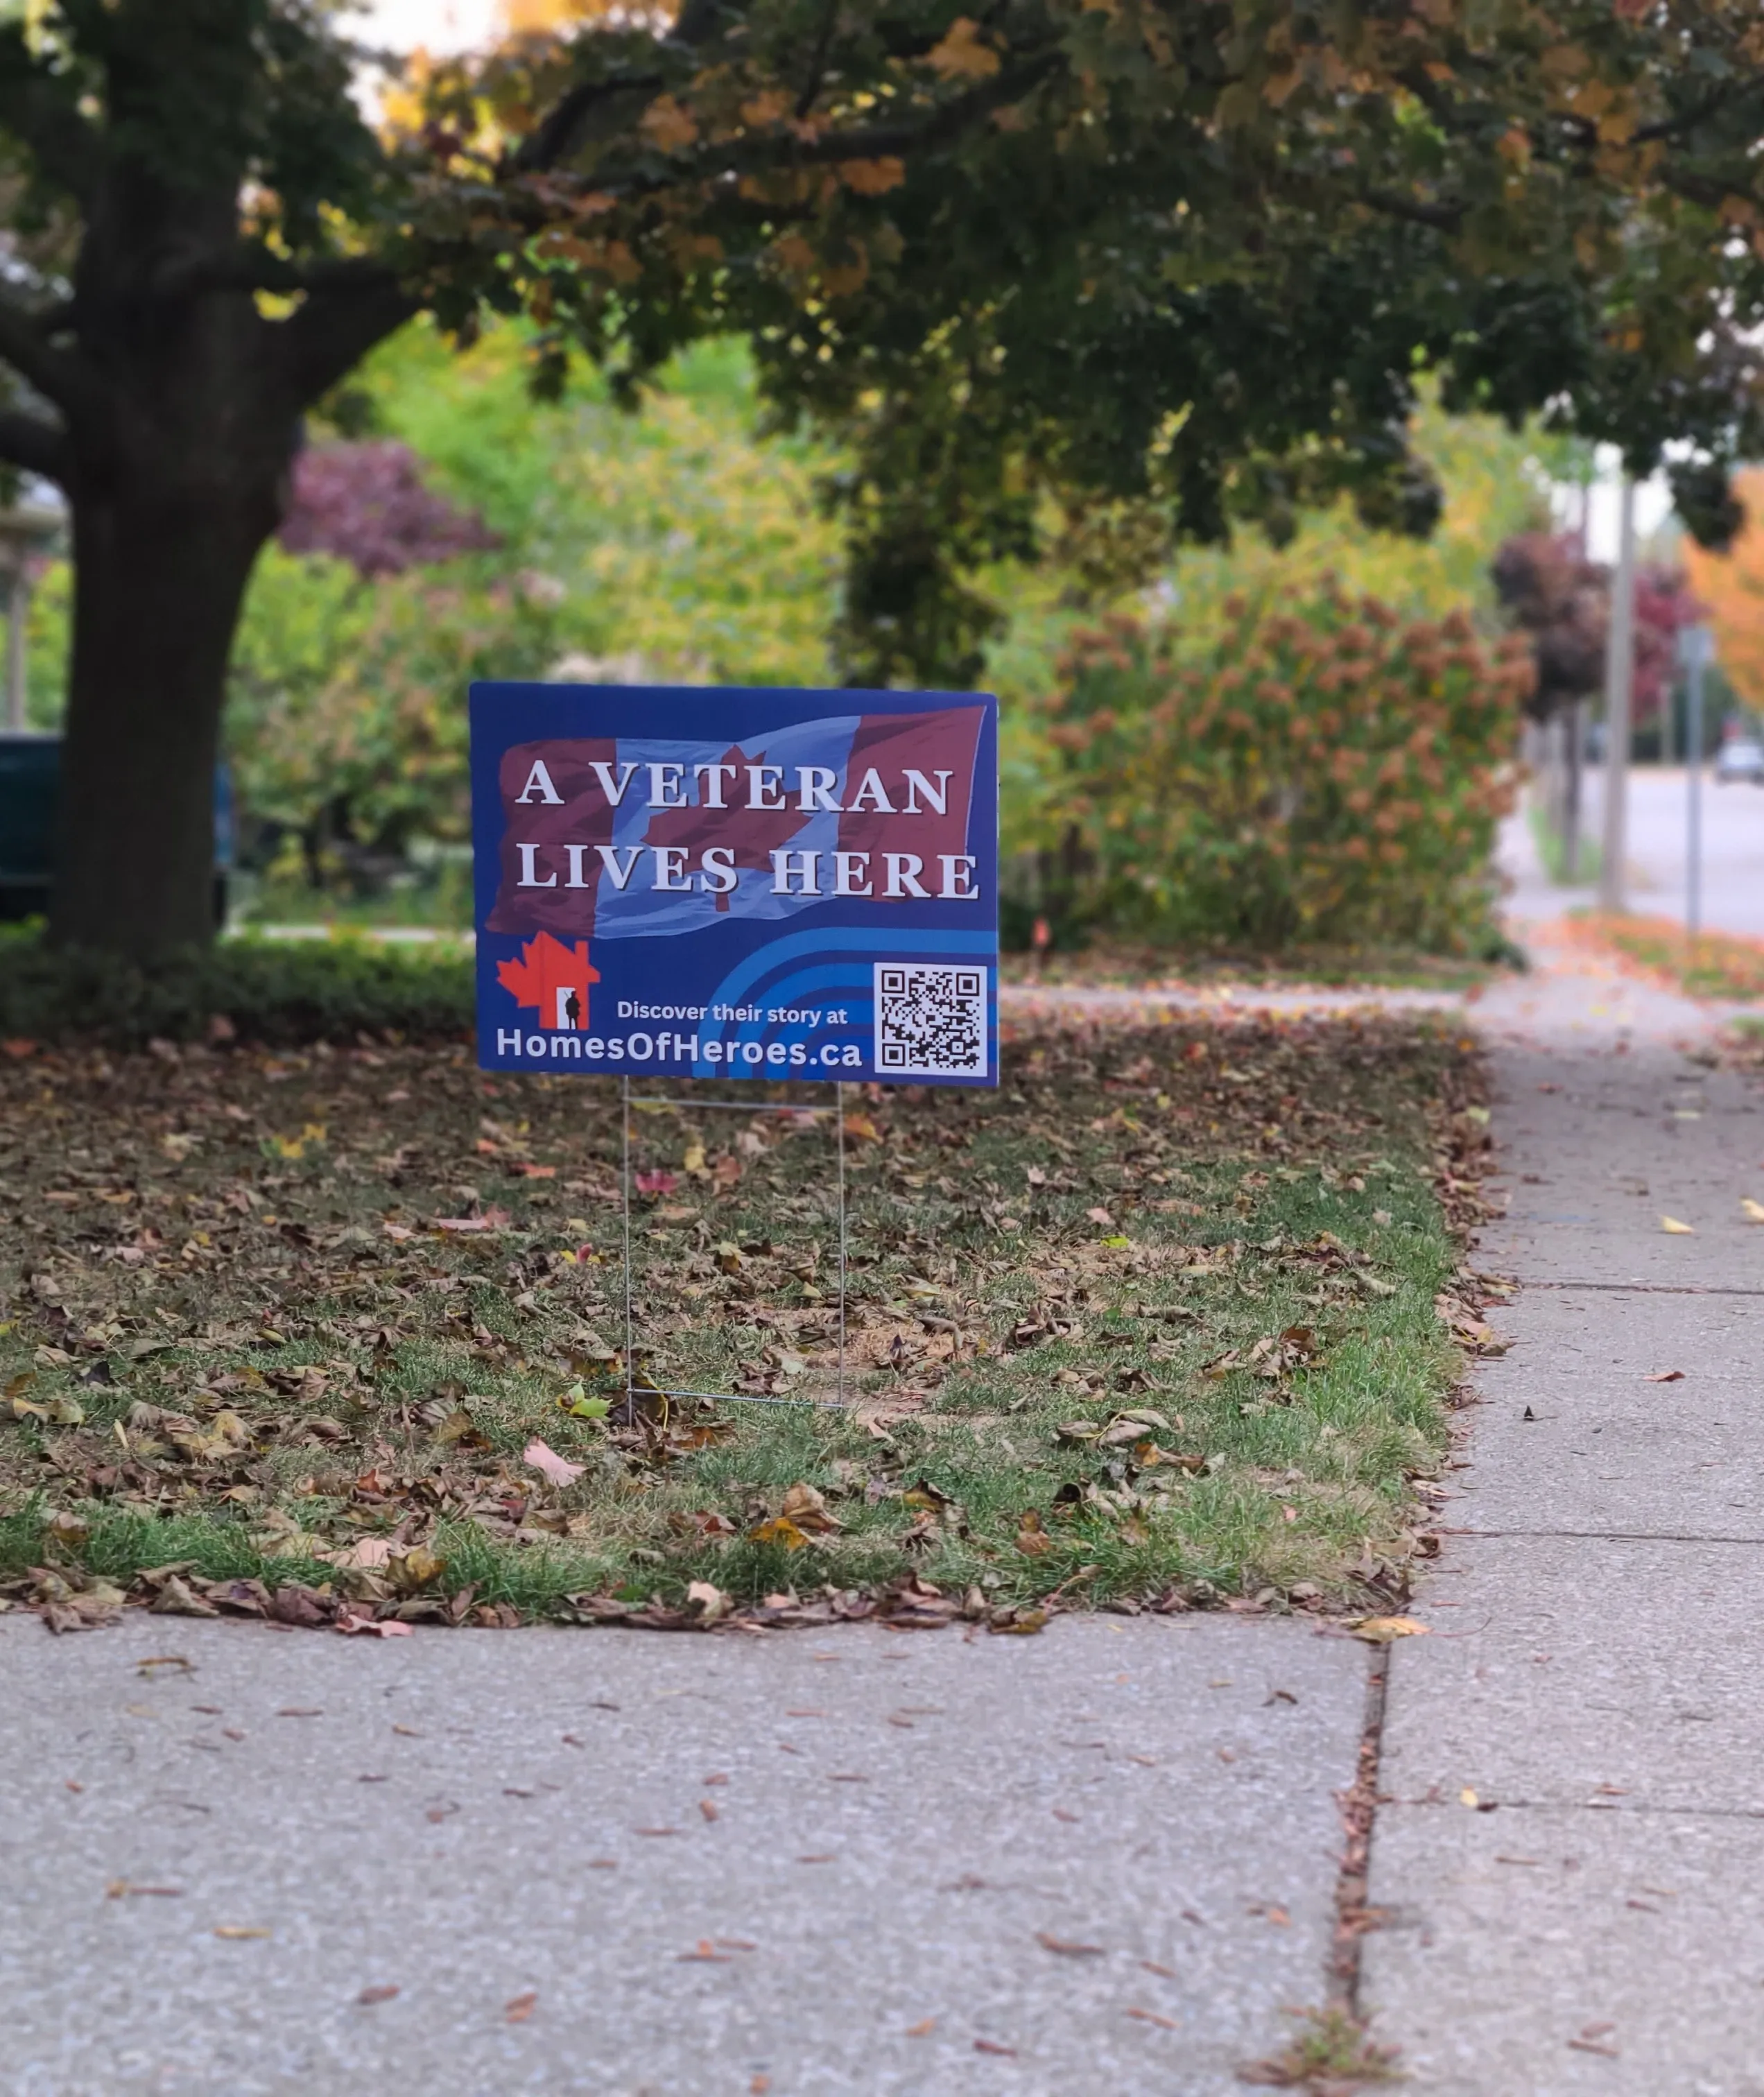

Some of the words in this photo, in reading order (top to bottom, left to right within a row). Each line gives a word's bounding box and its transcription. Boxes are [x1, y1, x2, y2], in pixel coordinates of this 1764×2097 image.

[514, 759, 565, 806] A
[589, 760, 953, 816] VETERAN
[516, 843, 738, 893] LIVES
[769, 849, 979, 900] HERE
[617, 1001, 708, 1021] Discover
[712, 1003, 763, 1022] their
[767, 1006, 821, 1027] story
[826, 1008, 848, 1025] at
[496, 1029, 862, 1067] HomesOfHeroes.ca
